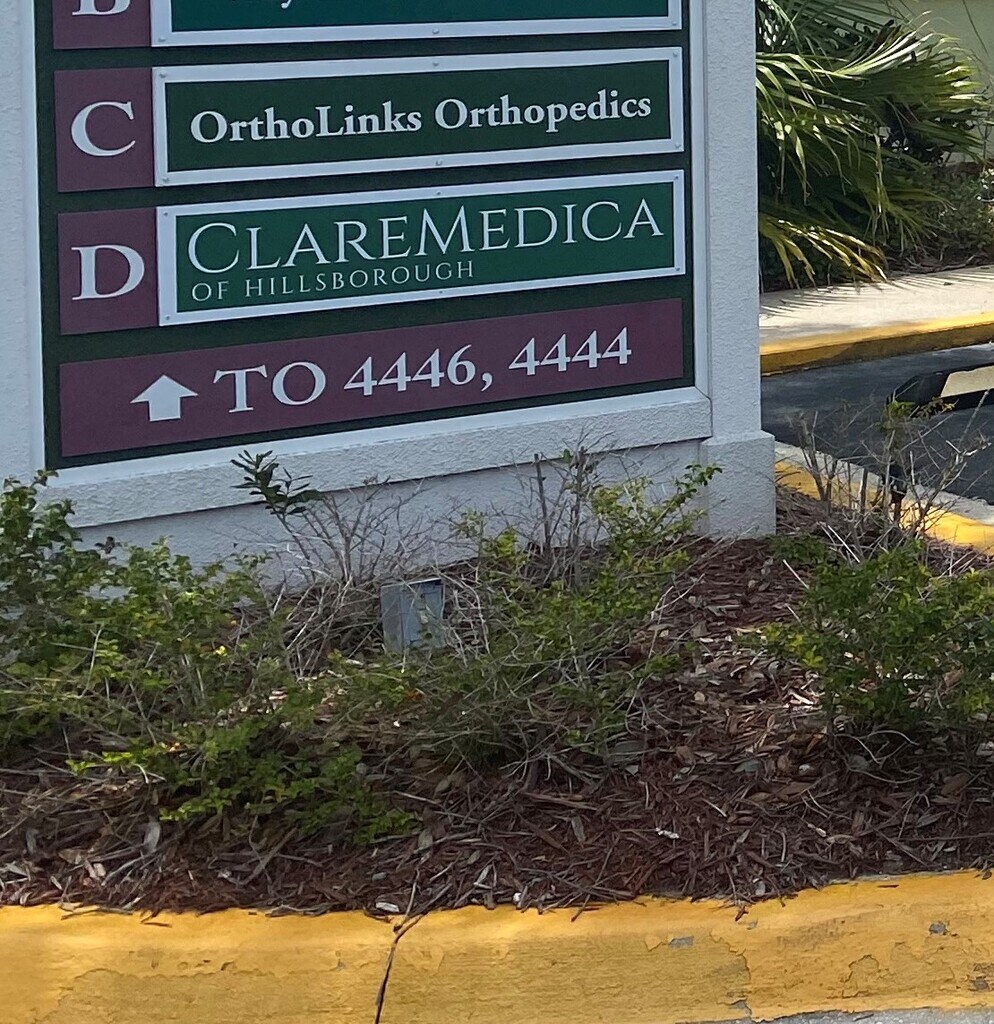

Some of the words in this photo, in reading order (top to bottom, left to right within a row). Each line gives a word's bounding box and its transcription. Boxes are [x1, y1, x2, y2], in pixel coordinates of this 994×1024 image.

[71, 101, 136, 157] C
[190, 100, 422, 143] OrthoLinks
[435, 88, 652, 134] Orthopedics
[71, 244, 145, 301] D
[191, 280, 230, 303] OF
[244, 260, 475, 298] HILLSBOROUGH
[213, 362, 326, 413] TO
[344, 344, 493, 392] 4446,
[508, 327, 632, 376] 4444
